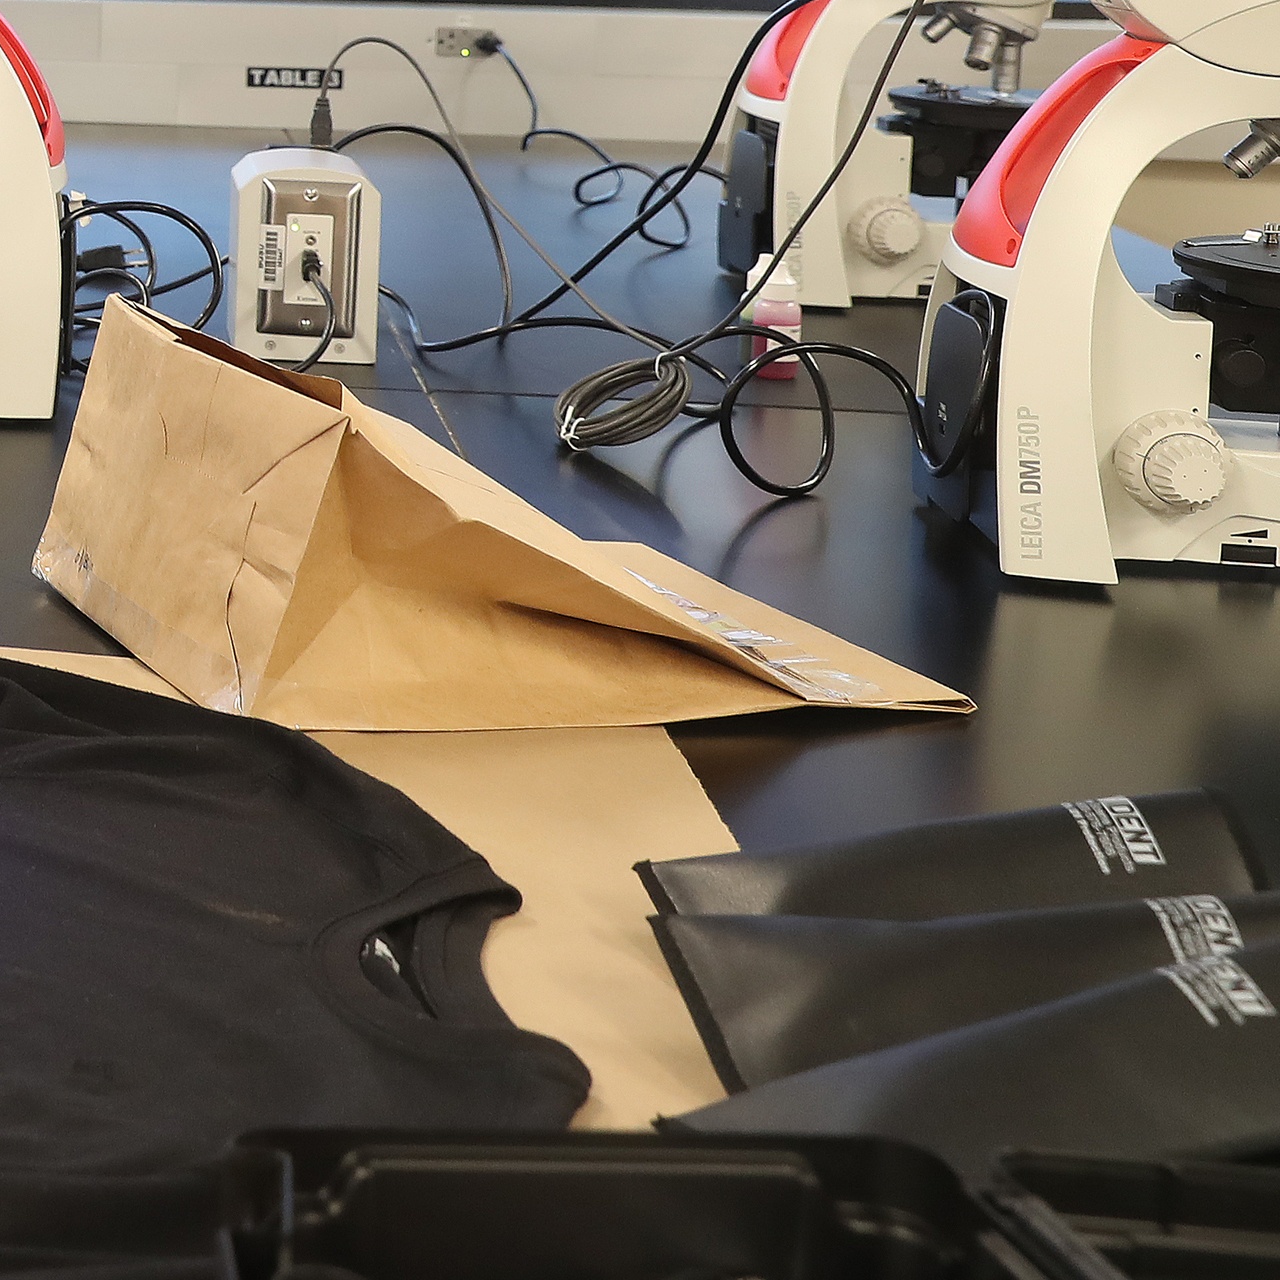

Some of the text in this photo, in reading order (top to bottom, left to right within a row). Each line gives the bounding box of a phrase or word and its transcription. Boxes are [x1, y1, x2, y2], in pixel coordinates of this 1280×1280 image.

[248, 69, 321, 87] TABLE
[1016, 405, 1043, 560] LEICA DM750P
